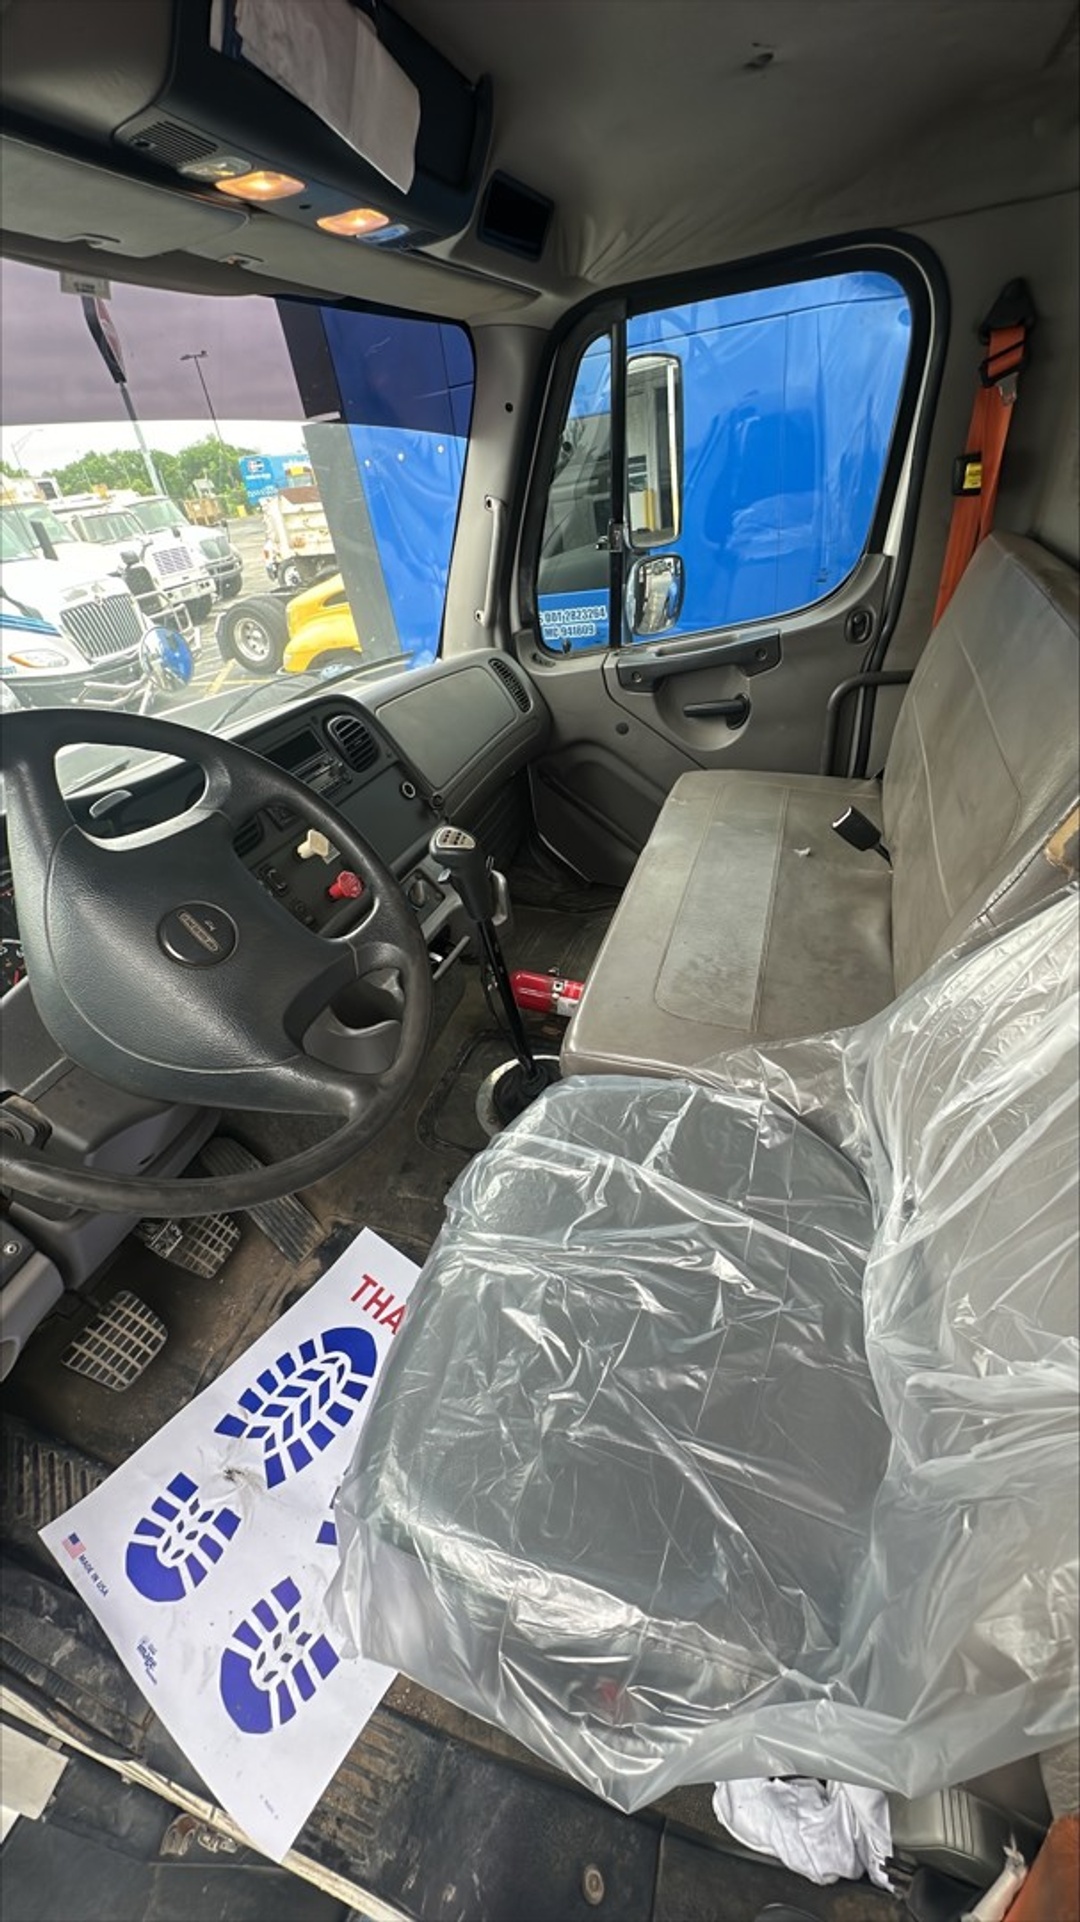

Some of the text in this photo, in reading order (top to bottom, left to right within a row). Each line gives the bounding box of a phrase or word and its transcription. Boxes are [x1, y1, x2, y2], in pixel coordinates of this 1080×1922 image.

[544, 611, 563, 623] DOT
[544, 624, 595, 638] MC 941809
[79, 1554, 109, 1597] MADE IN USA
